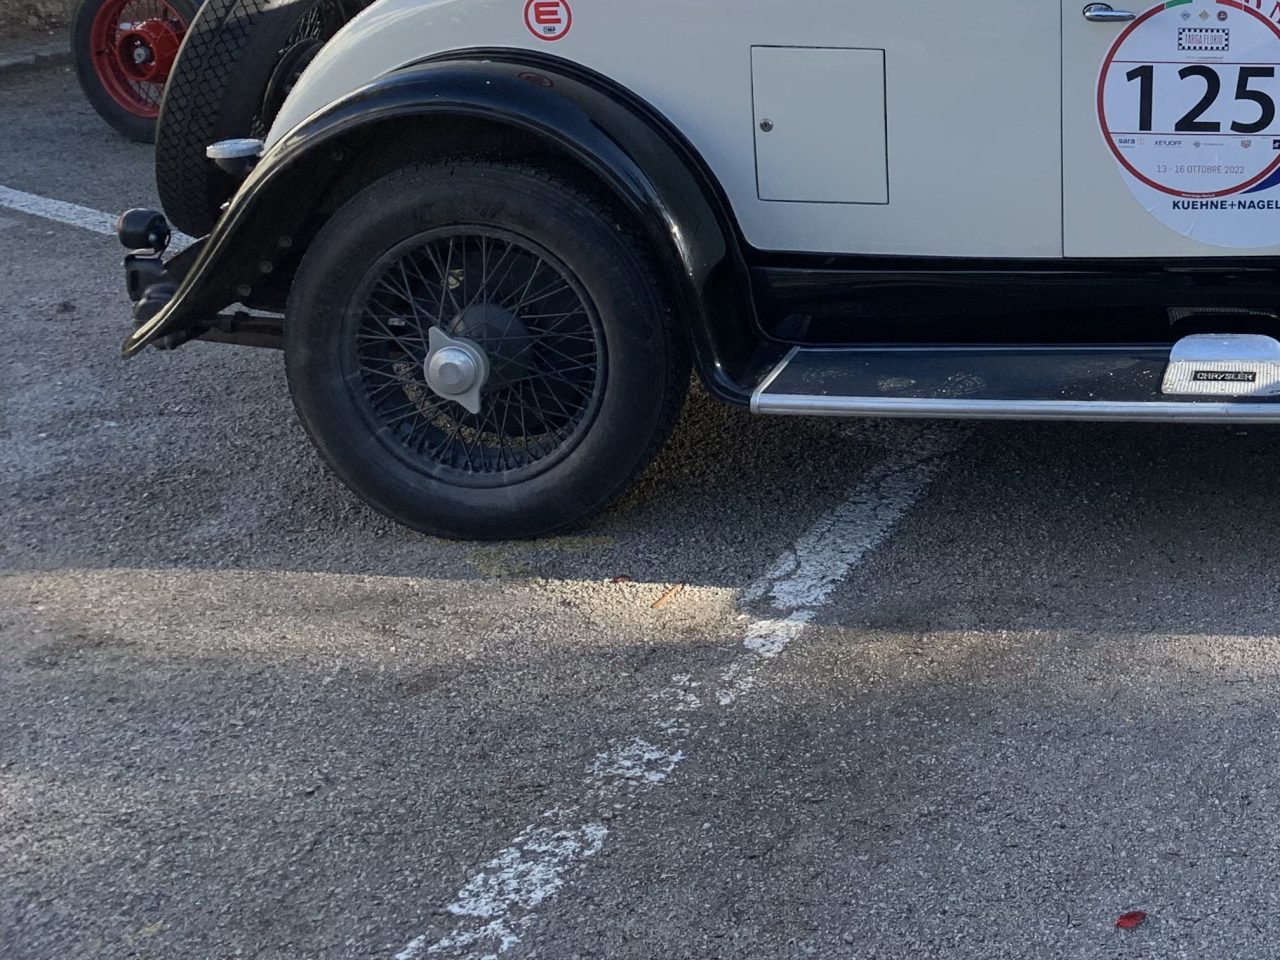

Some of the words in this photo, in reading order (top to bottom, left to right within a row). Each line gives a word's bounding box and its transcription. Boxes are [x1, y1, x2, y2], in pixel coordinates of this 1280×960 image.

[1126, 65, 1275, 133] 125
[1157, 165, 1167, 173] 13
[1175, 165, 1185, 173] 16
[1187, 165, 1223, 174] OTTOBRE
[1224, 165, 1245, 174] 2022
[1196, 372, 1253, 380] CHRYSLER
